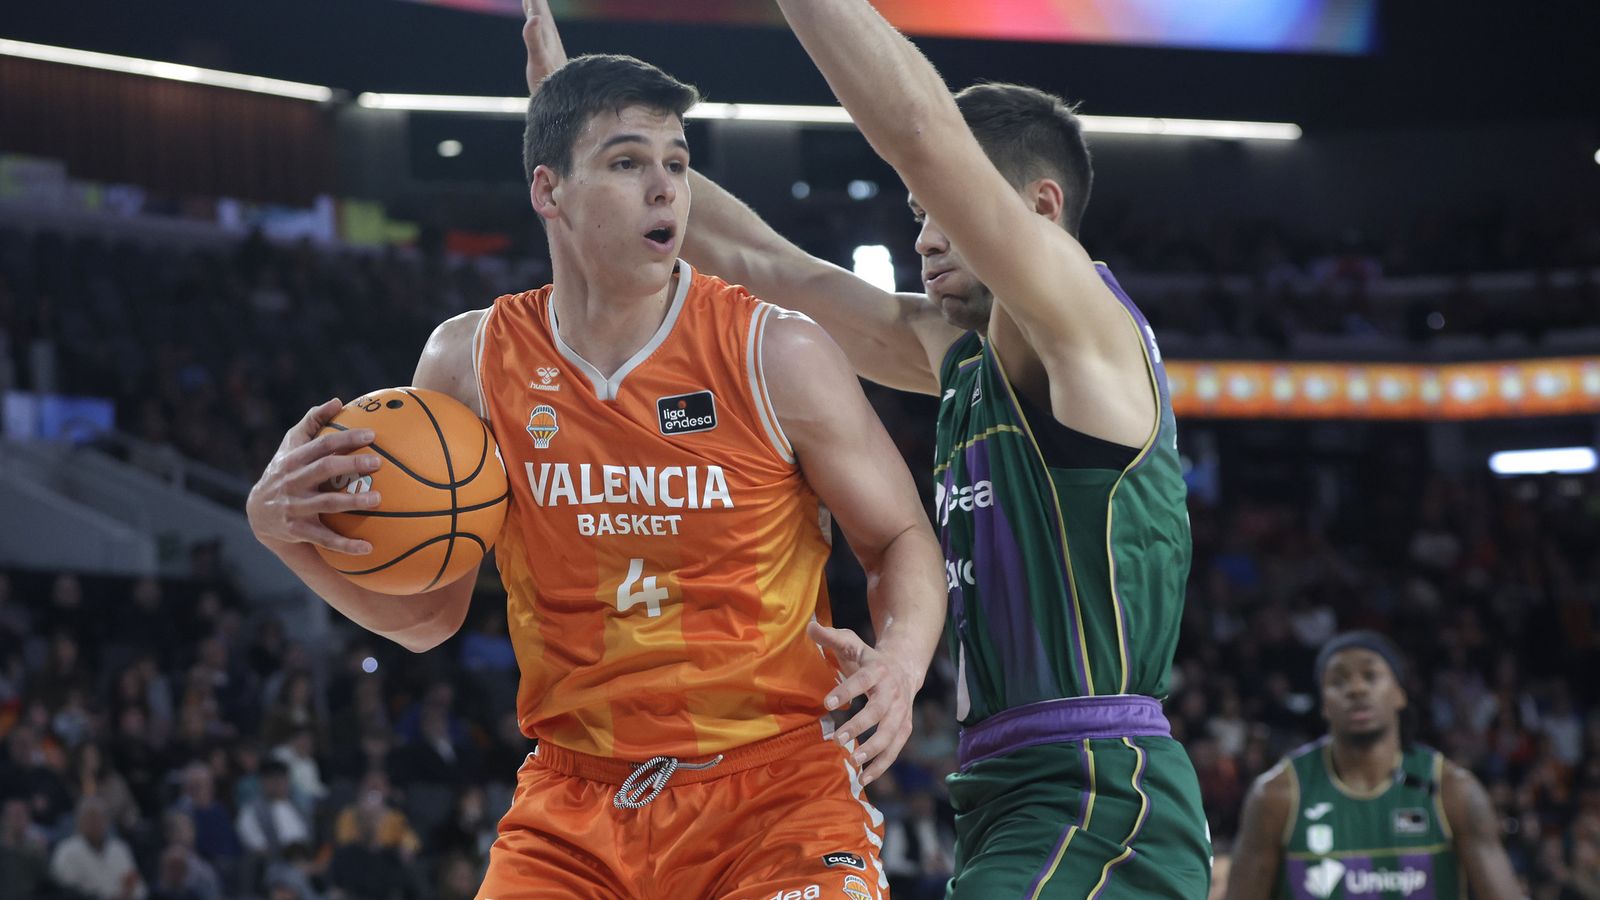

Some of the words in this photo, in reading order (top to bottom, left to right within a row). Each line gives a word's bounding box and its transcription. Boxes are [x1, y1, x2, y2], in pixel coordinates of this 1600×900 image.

[529, 381, 560, 391] hummel
[663, 408, 686, 421] liga
[665, 415, 713, 430] endesa
[524, 462, 735, 509] VALENCIA
[577, 513, 682, 537] BASKET
[616, 558, 670, 618] 4
[828, 855, 857, 865] acb
